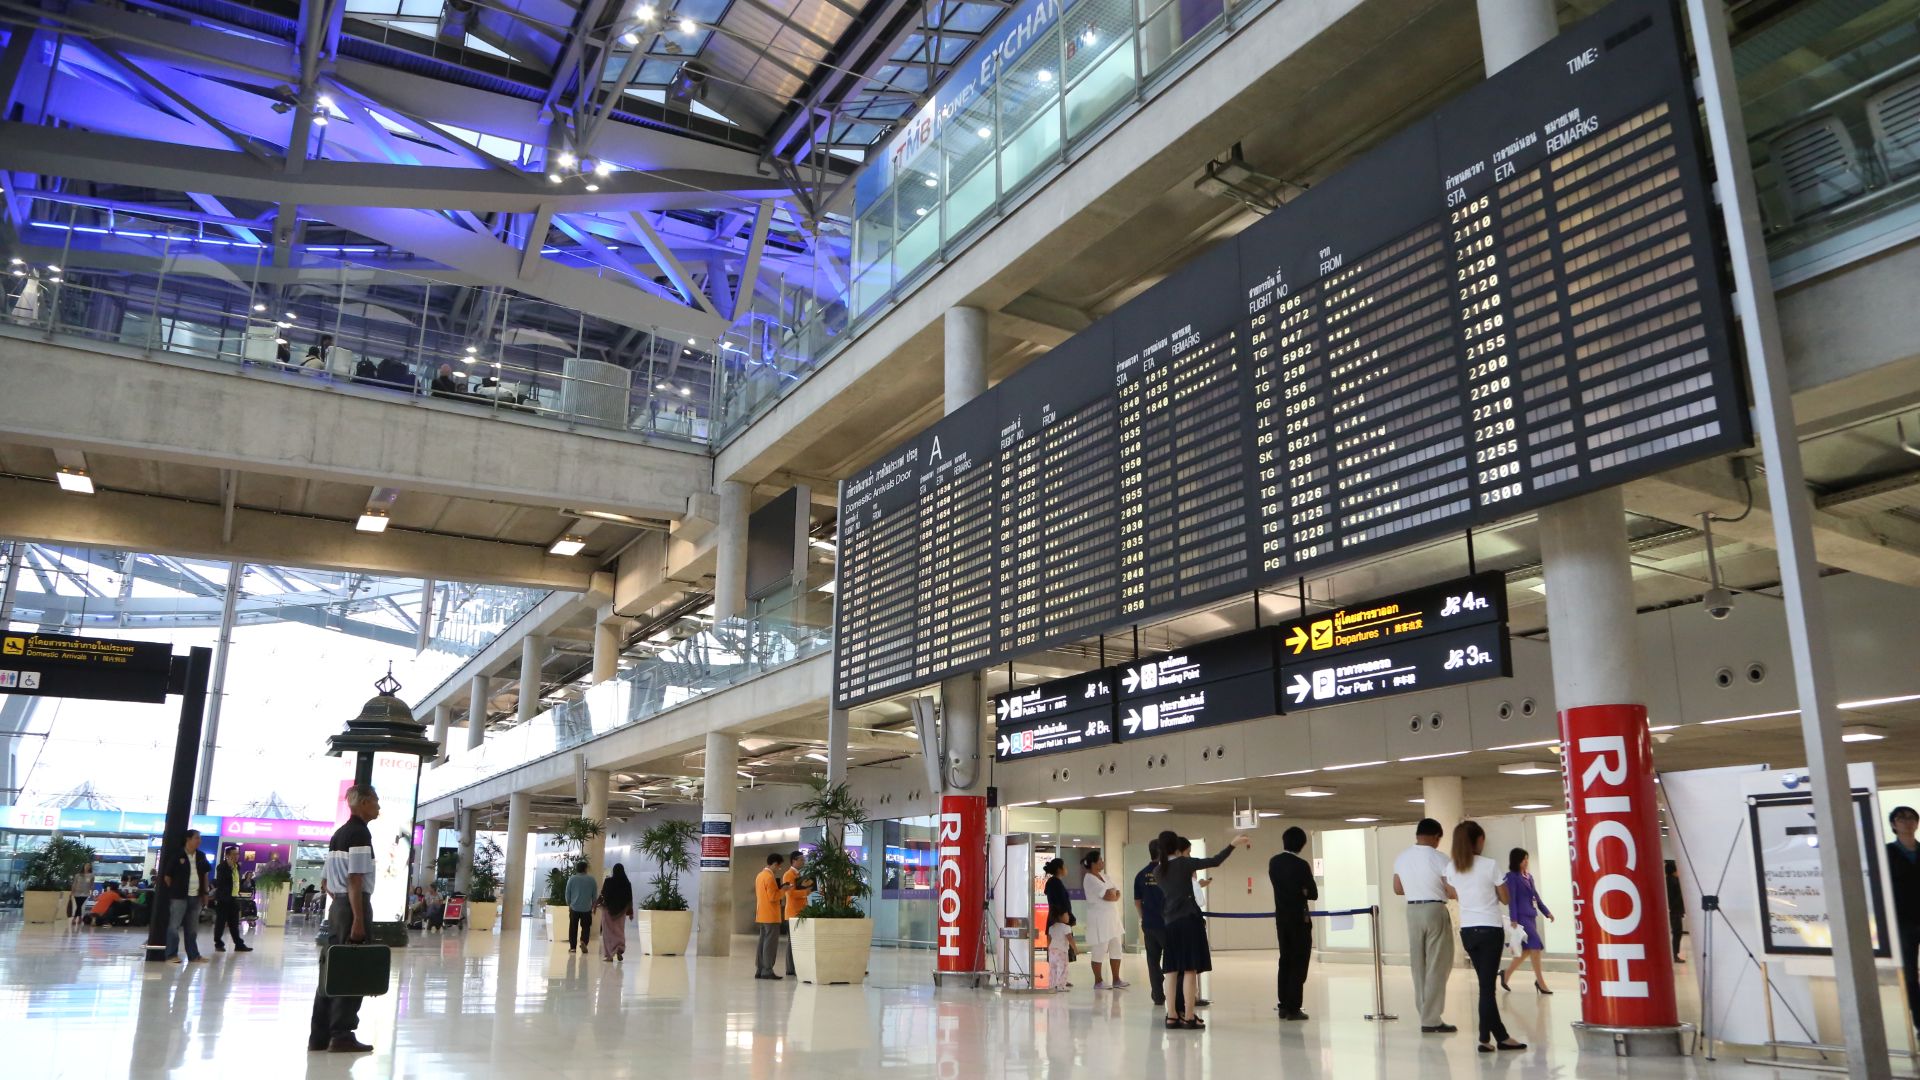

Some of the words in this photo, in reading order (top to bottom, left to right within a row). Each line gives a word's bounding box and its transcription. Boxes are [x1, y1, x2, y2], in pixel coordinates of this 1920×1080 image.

[1567, 48, 1598, 74] TIME:
[896, 118, 931, 167] TMB
[937, 78, 977, 130] MONEY
[1448, 187, 1466, 208] STA
[1495, 161, 1515, 182] ETA
[1546, 116, 1599, 154] REMARKS
[1252, 315, 1265, 328] PG
[1280, 296, 1300, 313] 806
[1452, 196, 1488, 223] 2105
[1320, 254, 1342, 276] FROM
[1253, 332, 1266, 345] BA
[1281, 309, 1308, 329] 4172
[1455, 216, 1490, 242] 2110
[1250, 292, 1272, 314] FLIGHT
[1277, 284, 1288, 299] NO
[1254, 348, 1267, 360] TG
[1282, 330, 1302, 347] 047
[1458, 235, 1493, 260] 2110
[1256, 366, 1267, 377] JL
[1283, 344, 1311, 364] 5982
[1459, 255, 1495, 281] 2120
[1256, 382, 1269, 394] TG
[1284, 365, 1305, 382] 250
[1461, 275, 1497, 300] 2120
[1117, 373, 1127, 386] STA
[1144, 358, 1155, 372] ETA
[1172, 332, 1200, 356] REMARKS
[1257, 399, 1270, 412] PG
[1285, 382, 1306, 399] 356
[1464, 294, 1500, 319] 2140
[1120, 382, 1139, 397] 1835
[1146, 366, 1167, 384] 1815
[1259, 417, 1270, 428] JL
[1287, 397, 1315, 416] 5908
[1465, 315, 1503, 339] 2150
[1120, 397, 1139, 413] 1840
[1147, 382, 1167, 399] 1835
[1258, 433, 1272, 446] PG
[1287, 418, 1308, 434] 264
[1468, 334, 1505, 359] 2155
[1121, 411, 1139, 427] 1845
[1147, 397, 1168, 414] 1840
[1260, 450, 1272, 463] SK
[1289, 433, 1316, 452] 8621
[1470, 356, 1507, 379] 2200
[1120, 427, 1140, 442] 1935
[1260, 468, 1274, 481] TG
[1290, 454, 1311, 470] 238
[1472, 377, 1509, 400] 2200
[929, 435, 942, 465] A
[1121, 442, 1140, 457] 1940
[1261, 486, 1275, 498] TG
[1292, 472, 1311, 487] 121
[1474, 398, 1512, 421] 2210
[1121, 457, 1141, 473] 1950
[1262, 504, 1276, 516] TG
[1292, 488, 1321, 506] 2226
[1476, 419, 1514, 441] 2230
[846, 492, 872, 514] Domestic
[873, 479, 894, 498] Arrivals
[896, 470, 912, 485] Door
[1121, 473, 1141, 488] 1950
[1122, 488, 1142, 503] 1955
[1263, 522, 1277, 534] TG
[1293, 506, 1322, 525] 2125
[1478, 440, 1517, 463] 2255
[1122, 504, 1142, 519] 2030
[1264, 540, 1278, 553] PG
[1295, 525, 1323, 542] 1228
[1480, 462, 1519, 484] 2300
[1122, 520, 1142, 535] 2030
[1265, 558, 1279, 571] PG
[1296, 546, 1317, 561] 190
[1482, 483, 1521, 505] 2300
[1122, 535, 1143, 550] 2035
[1122, 551, 1143, 566] 2040
[1123, 568, 1143, 582] 2040
[1123, 583, 1143, 598] 2045
[1123, 600, 1144, 613] 2050
[1336, 628, 1379, 646] Departures
[27, 650, 58, 658] Domestic
[62, 652, 86, 660] Arrivals
[1159, 674, 1182, 686] Meeting
[1183, 669, 1200, 680] Point
[1337, 684, 1352, 696] Car
[1354, 680, 1373, 693] Park
[1023, 705, 1036, 716] Public
[1160, 714, 1194, 728] Information
[1034, 742, 1046, 750] Airport
[1579, 736, 1648, 998] RICOH
[940, 812, 961, 956] RICOH
[1572, 880, 1588, 995] change
